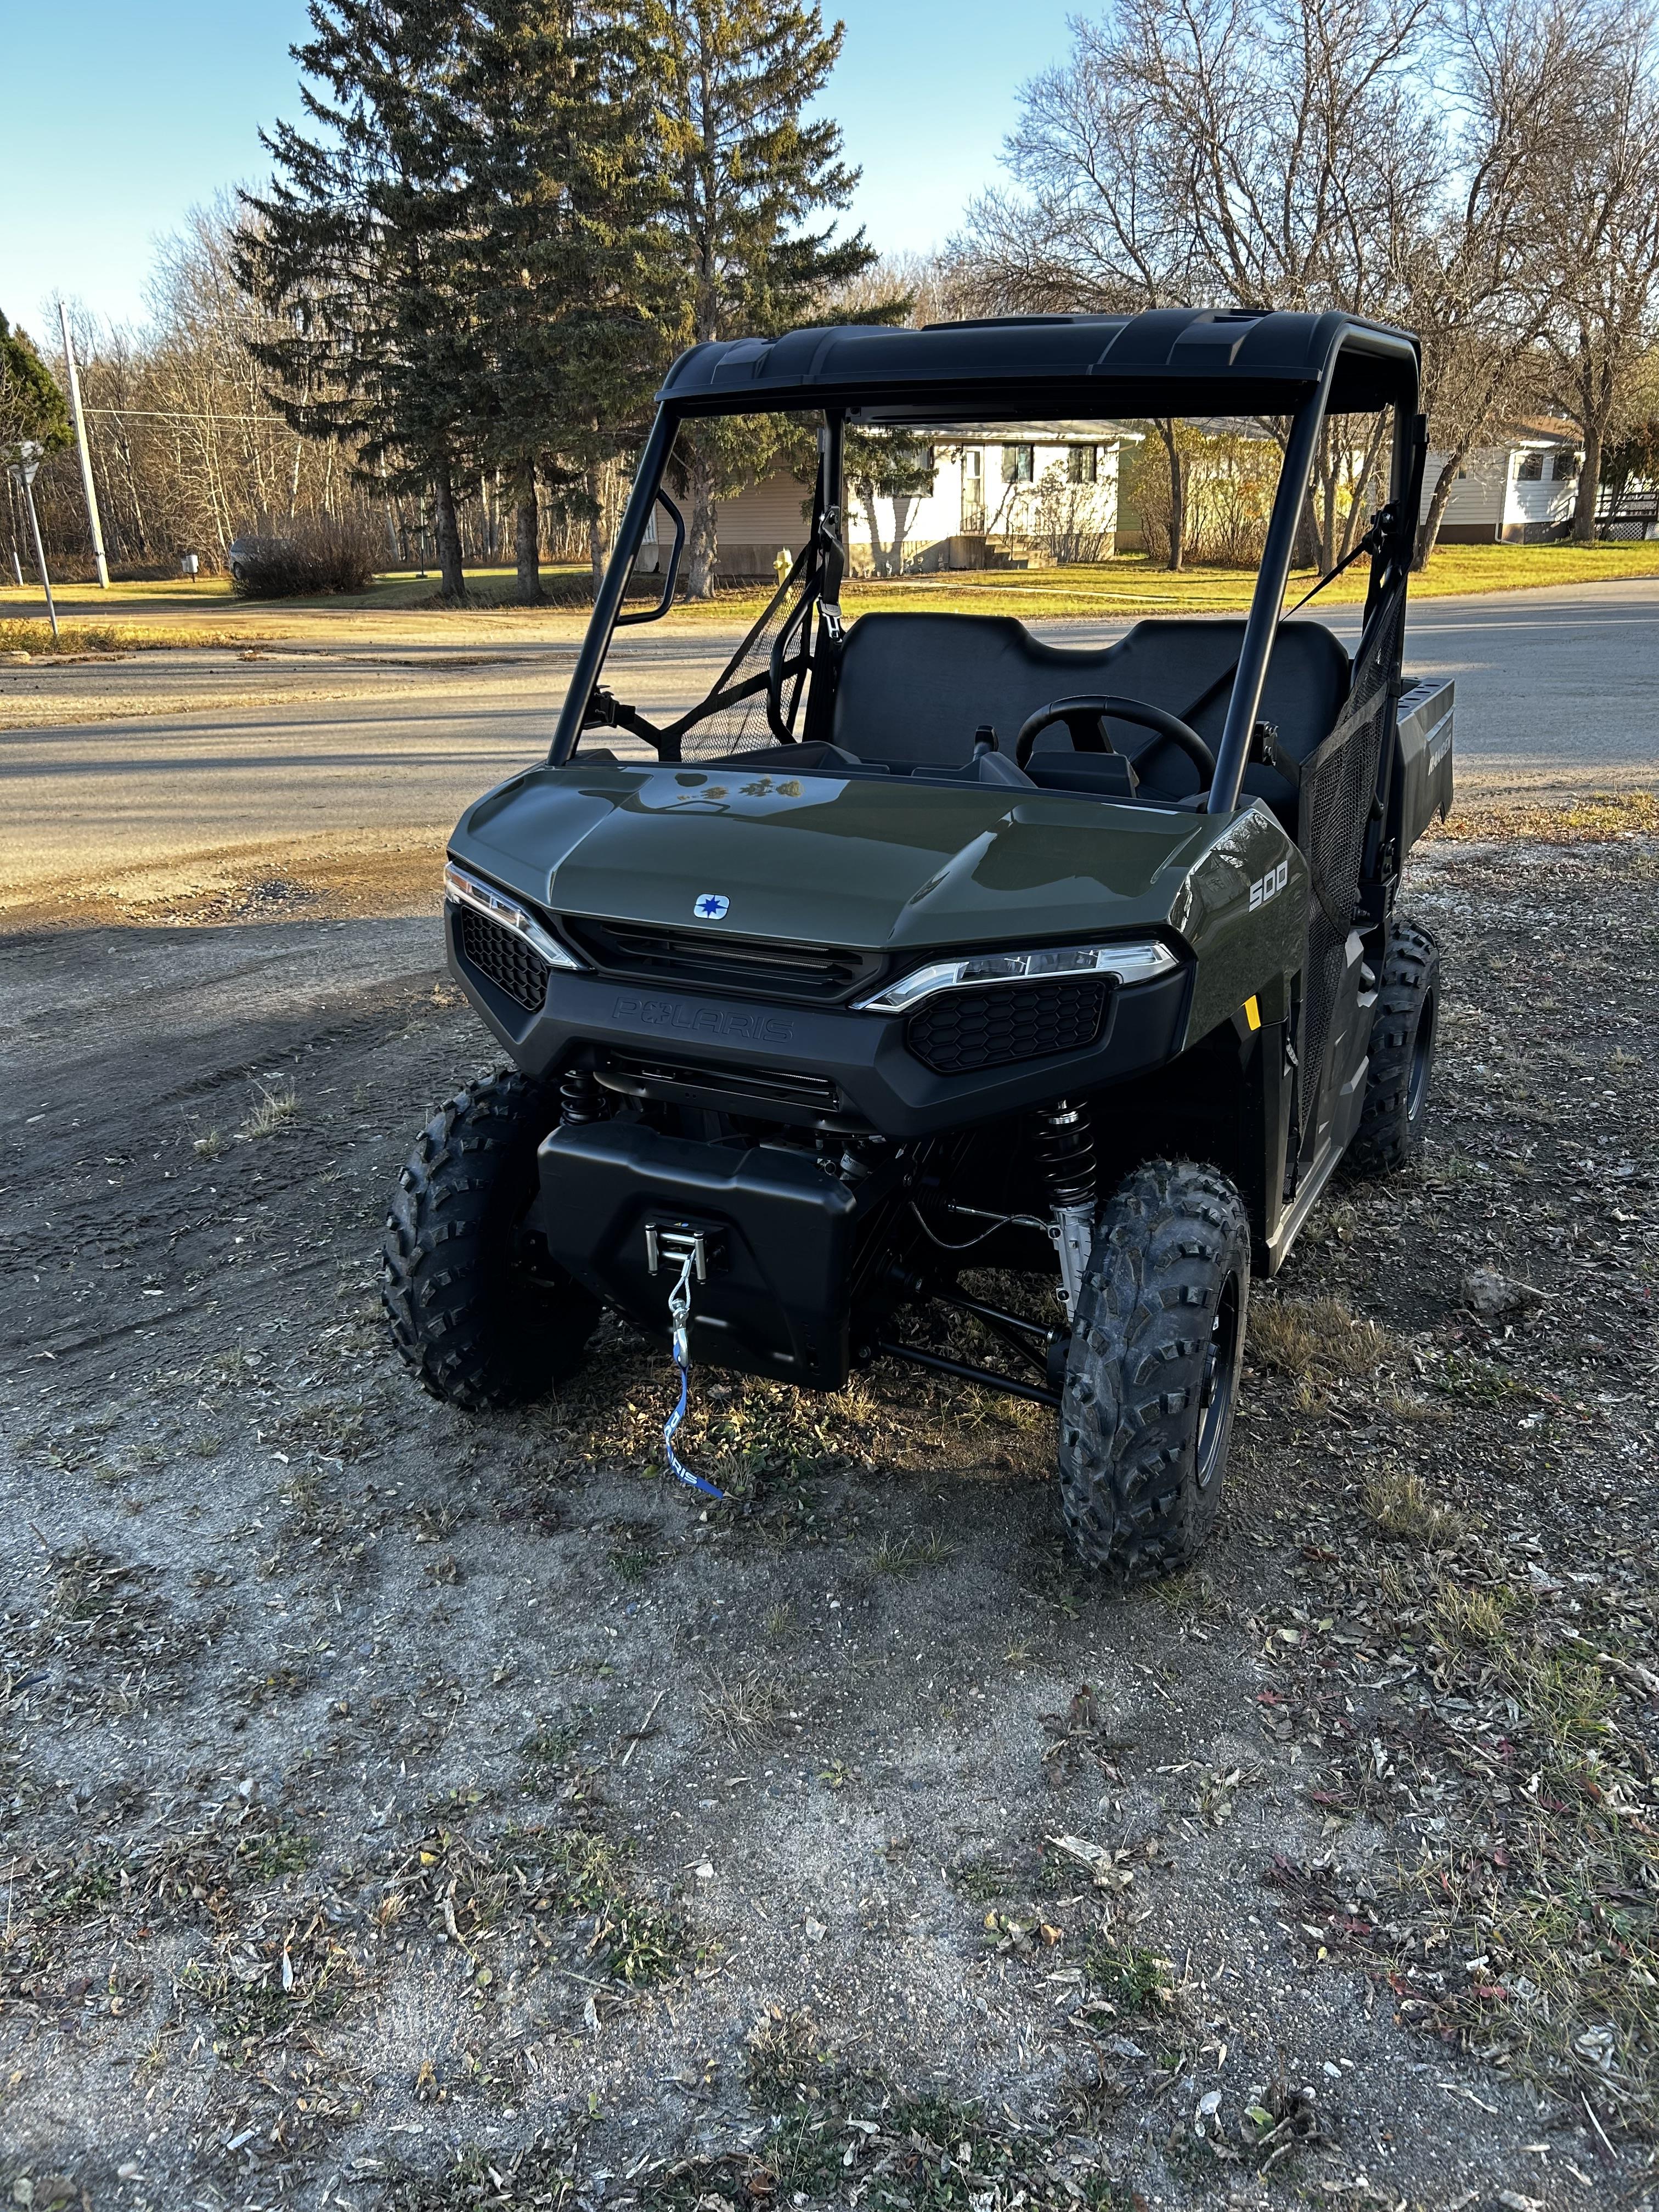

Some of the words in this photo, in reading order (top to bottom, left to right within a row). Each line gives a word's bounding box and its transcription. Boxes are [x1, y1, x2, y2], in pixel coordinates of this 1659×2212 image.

[1249, 860, 1288, 912] 500
[612, 996, 794, 1043] POLARIS
[664, 1411, 697, 1484] PORIS
